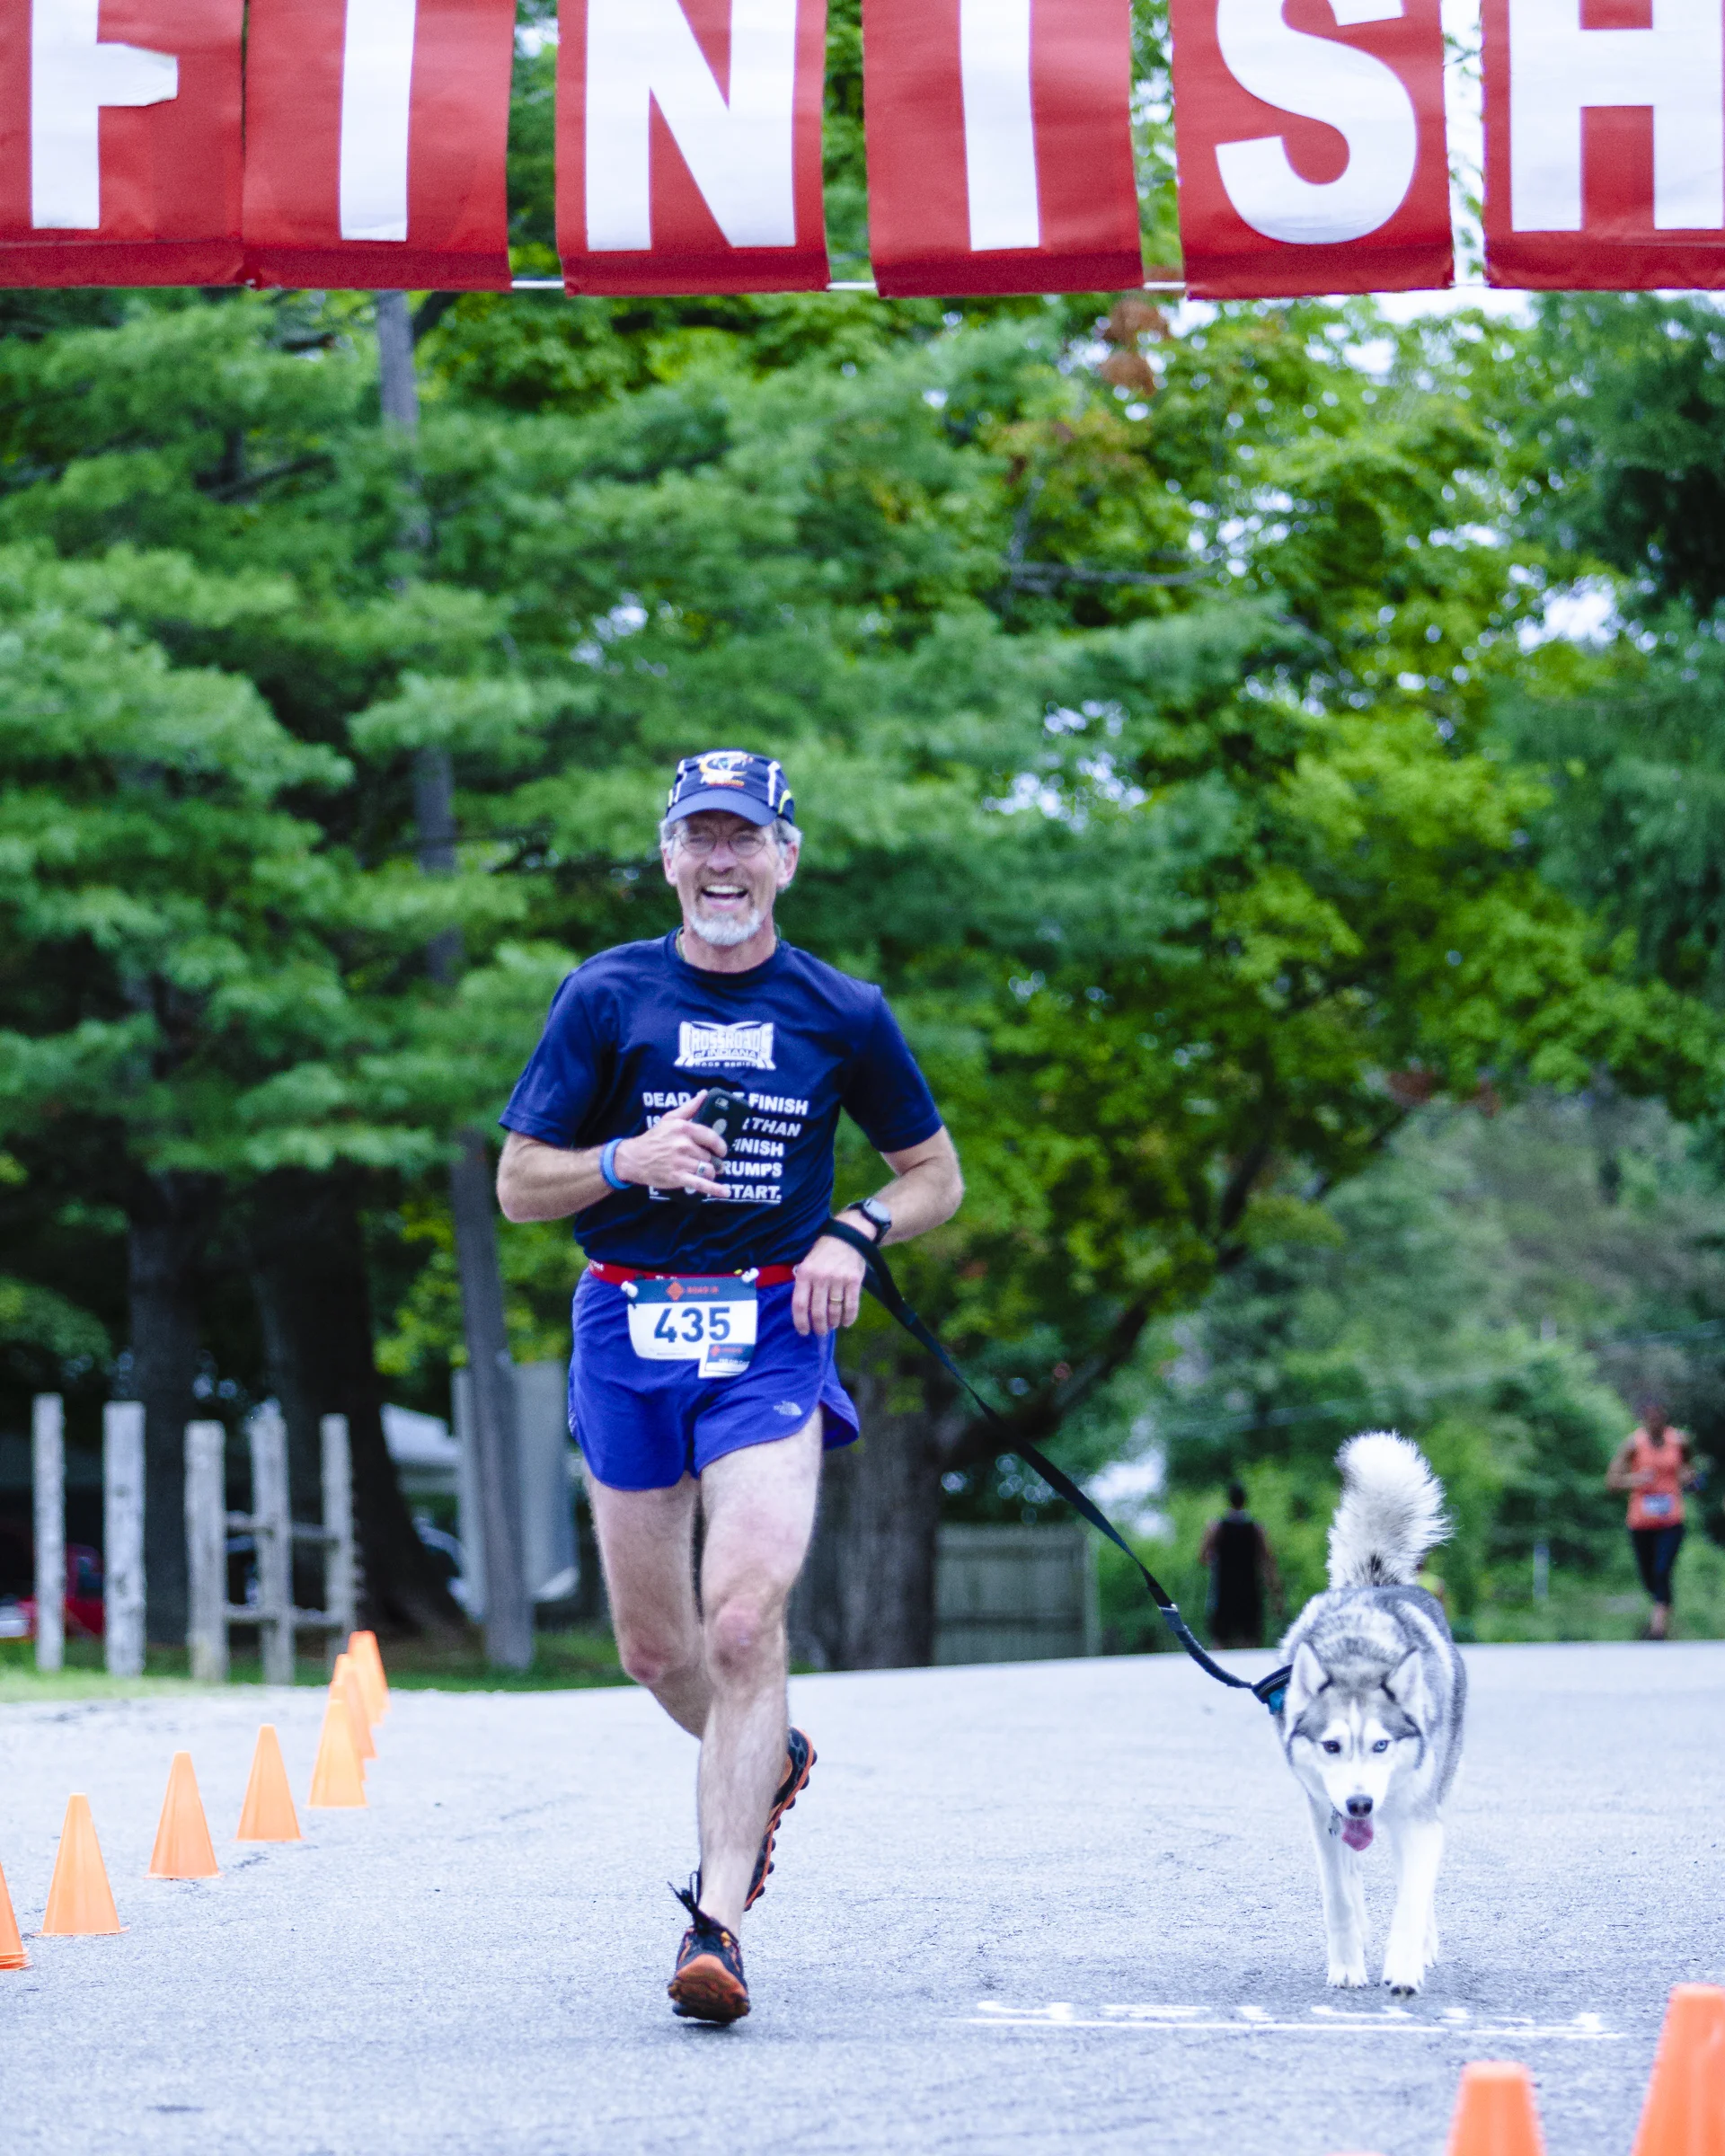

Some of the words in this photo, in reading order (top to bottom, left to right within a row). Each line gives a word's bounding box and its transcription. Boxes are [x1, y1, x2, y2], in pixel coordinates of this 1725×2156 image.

[31, 0, 1725, 251] FINISH
[708, 1048, 757, 1058] INDIANA
[642, 1091, 691, 1107] DEAD
[748, 1092, 809, 1116] FINISH
[752, 1117, 801, 1137] THAN
[731, 1137, 784, 1157] INISH
[722, 1160, 783, 1179] RUMPS
[654, 1306, 730, 1343] 435
